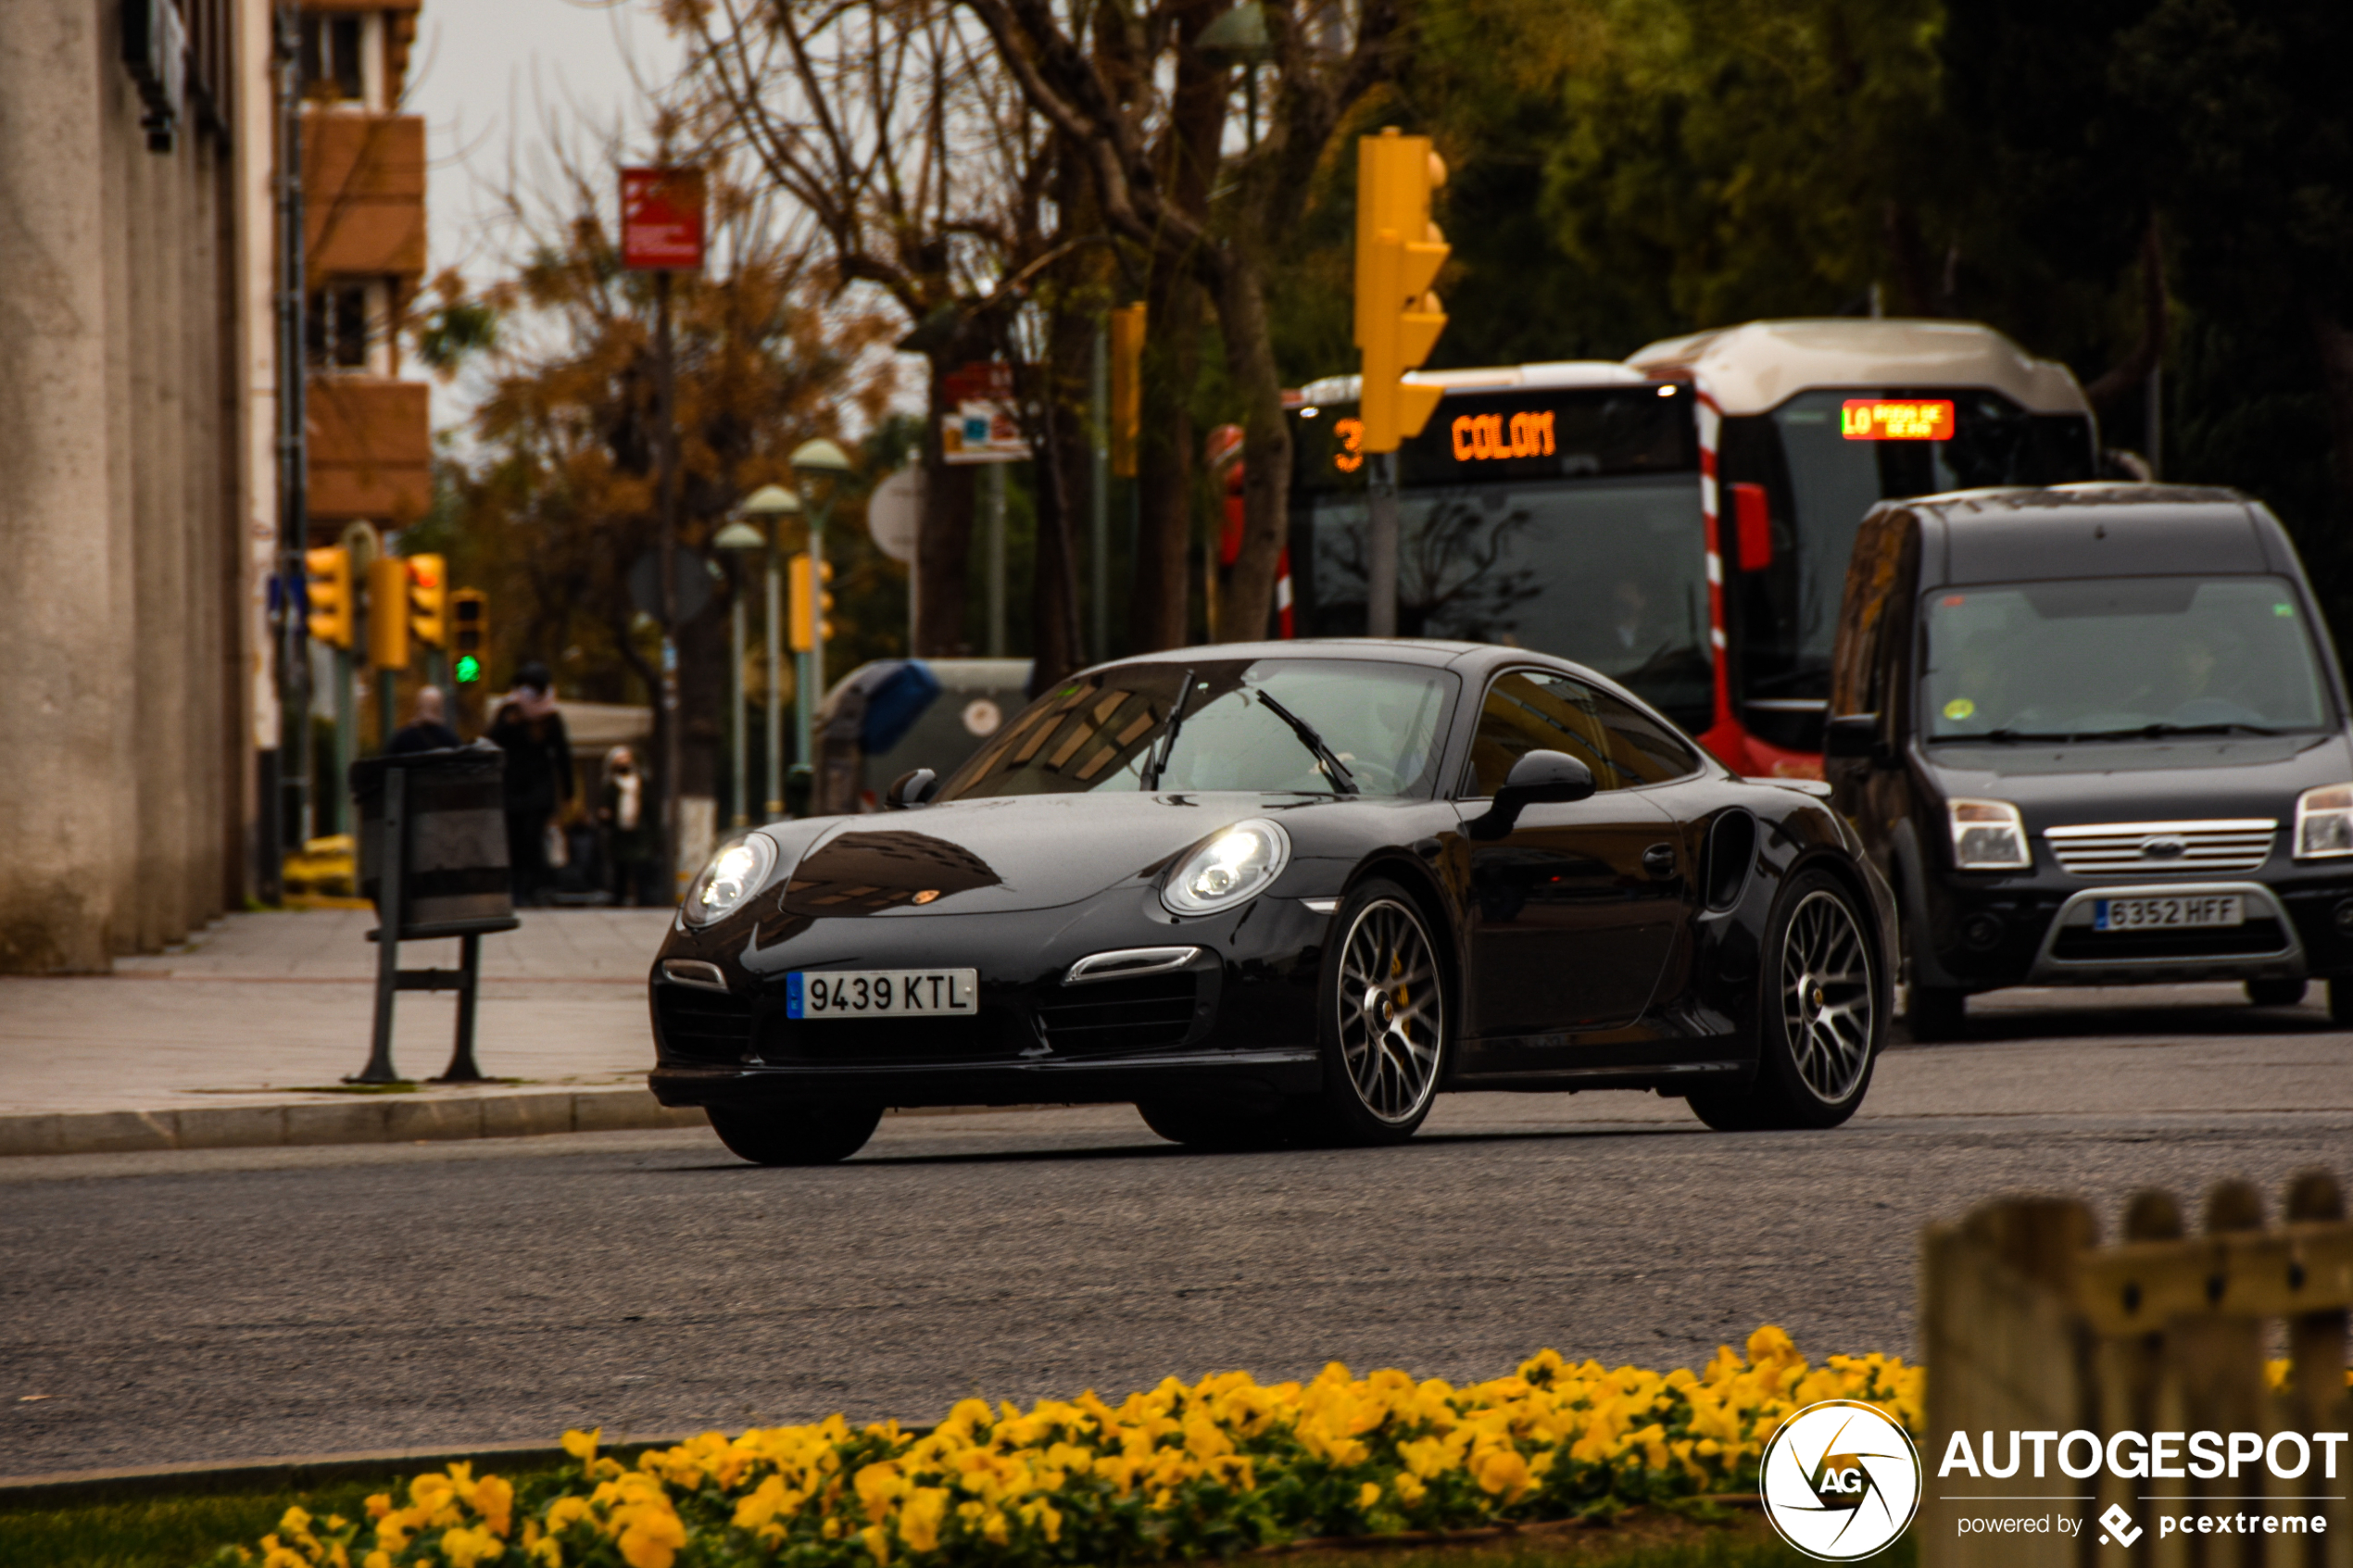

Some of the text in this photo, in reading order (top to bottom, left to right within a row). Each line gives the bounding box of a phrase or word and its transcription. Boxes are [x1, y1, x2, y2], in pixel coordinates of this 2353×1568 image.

[1452, 409, 1555, 461] COLOM
[2110, 898, 2233, 925] 6352 HFF
[810, 975, 967, 1011] 9439 KTL
